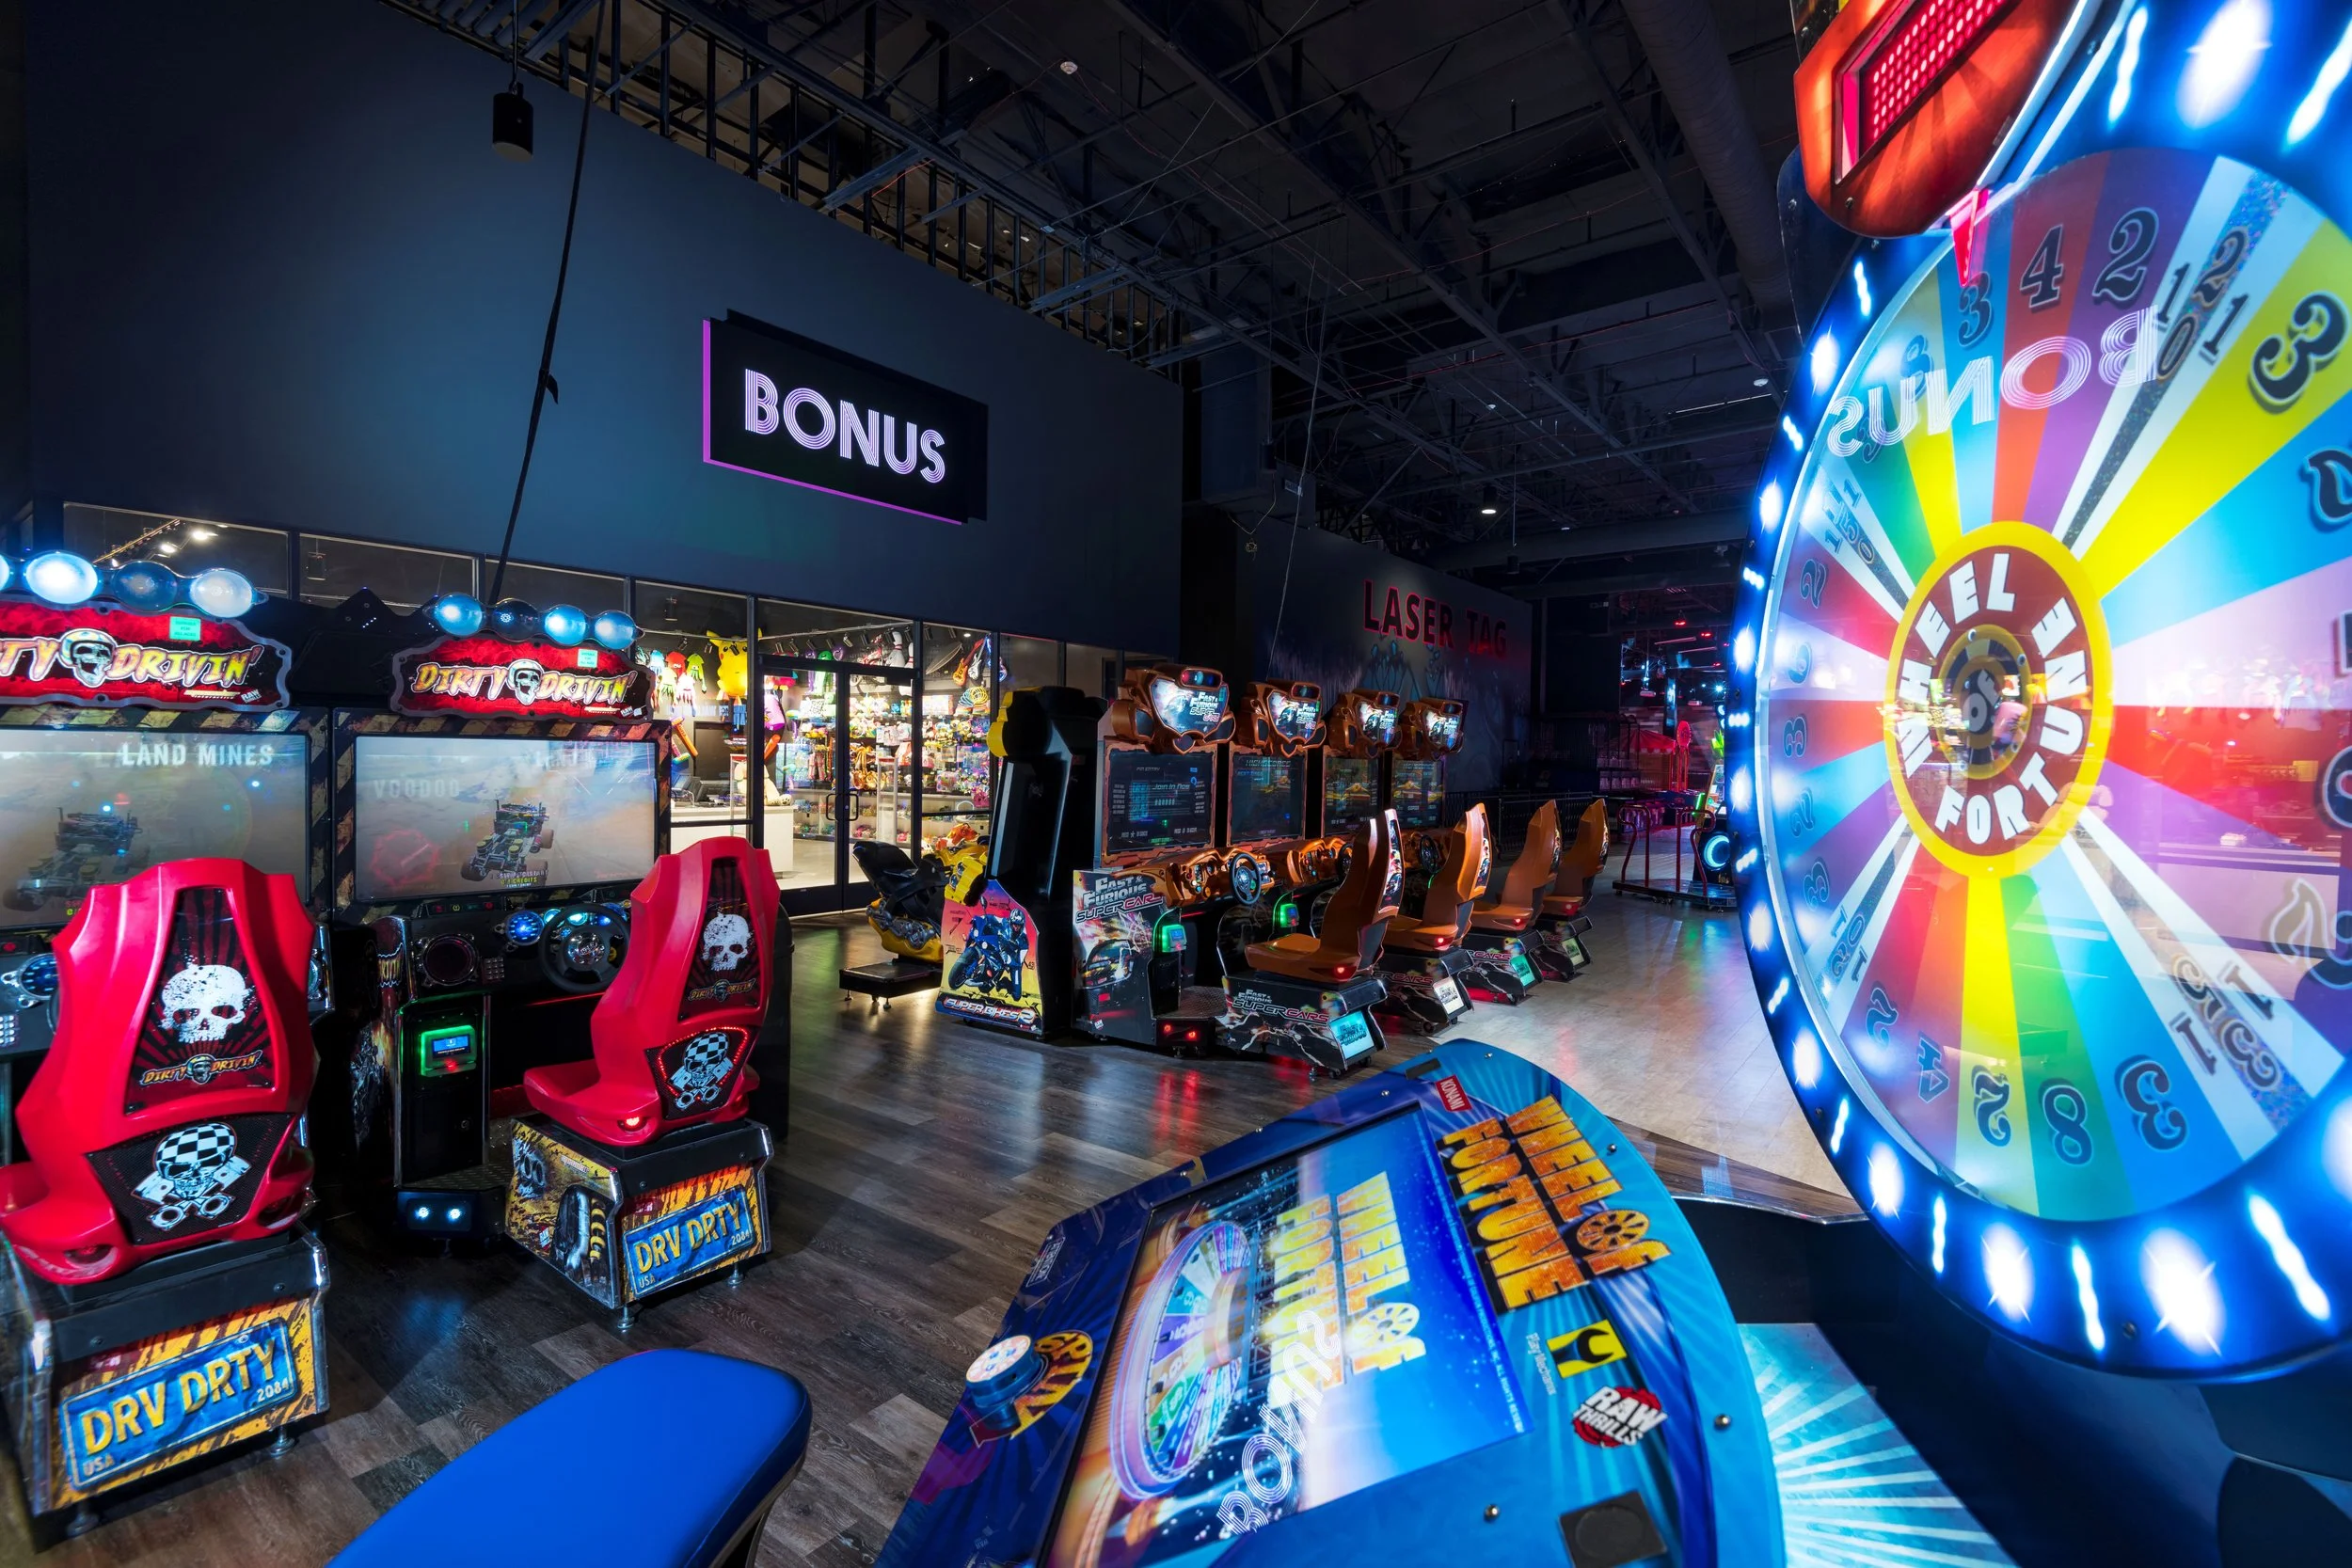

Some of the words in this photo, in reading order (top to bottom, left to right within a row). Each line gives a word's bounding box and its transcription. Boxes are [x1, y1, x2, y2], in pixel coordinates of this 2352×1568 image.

[2020, 224, 2064, 309] 4
[2091, 206, 2159, 302] 2
[1958, 271, 1993, 347] 3
[2153, 261, 2191, 326] 1
[2202, 293, 2249, 358] 1
[2251, 291, 2351, 404] 3
[745, 368, 946, 483] BONUS
[1799, 558, 1828, 610] 2
[1364, 579, 1454, 649] LASER
[1466, 610, 1507, 658] TAG
[105, 643, 263, 688] DRIVIN'
[411, 661, 509, 700] DIRTY
[534, 671, 638, 705] DRIVIN'
[1895, 553, 2016, 779] WHEEL
[1933, 596, 2088, 845] FORTUNE
[1963, 669, 1996, 736] OF
[121, 742, 186, 766] LAND
[199, 743, 273, 766] MINES
[1784, 712, 1807, 758] 3
[374, 779, 460, 799] VOODOO
[1790, 788, 1815, 838] 2
[1075, 894, 1164, 923] SUPERCAR
[1083, 883, 1147, 910] FURIOUS
[1095, 876, 1133, 894] FAST
[1804, 859, 1830, 911] 3
[984, 1005, 1019, 1021] BIKES
[1018, 1008, 1035, 1024] 2
[1232, 999, 1330, 1023] SUPERCARS
[1867, 984, 1899, 1050] 2
[2222, 966, 2275, 1022] 1
[142, 1066, 187, 1084] DIRTY
[2175, 1016, 2217, 1077] 1
[1439, 1078, 1466, 1111] KONAMI
[1975, 1071, 2011, 1147] 2
[2121, 1060, 2188, 1151] 3
[2042, 1085, 2093, 1166] 8
[1506, 1095, 1623, 1222] WHEEL
[634, 1226, 681, 1274] DRV
[687, 1199, 741, 1250] DRTY
[731, 1230, 751, 1246] 2084
[1443, 1117, 1585, 1308] FORTUNE
[1336, 1171, 1410, 1316] WHEEL
[638, 1275, 656, 1289] USA
[1267, 1195, 1345, 1411] FORTUNE
[80, 1381, 167, 1456] DRV
[178, 1337, 276, 1415] DRTY
[256, 1378, 291, 1402] 2084
[1585, 1386, 1668, 1433] RAW
[1573, 1403, 1644, 1446] THRILLS
[82, 1453, 115, 1477] USA
